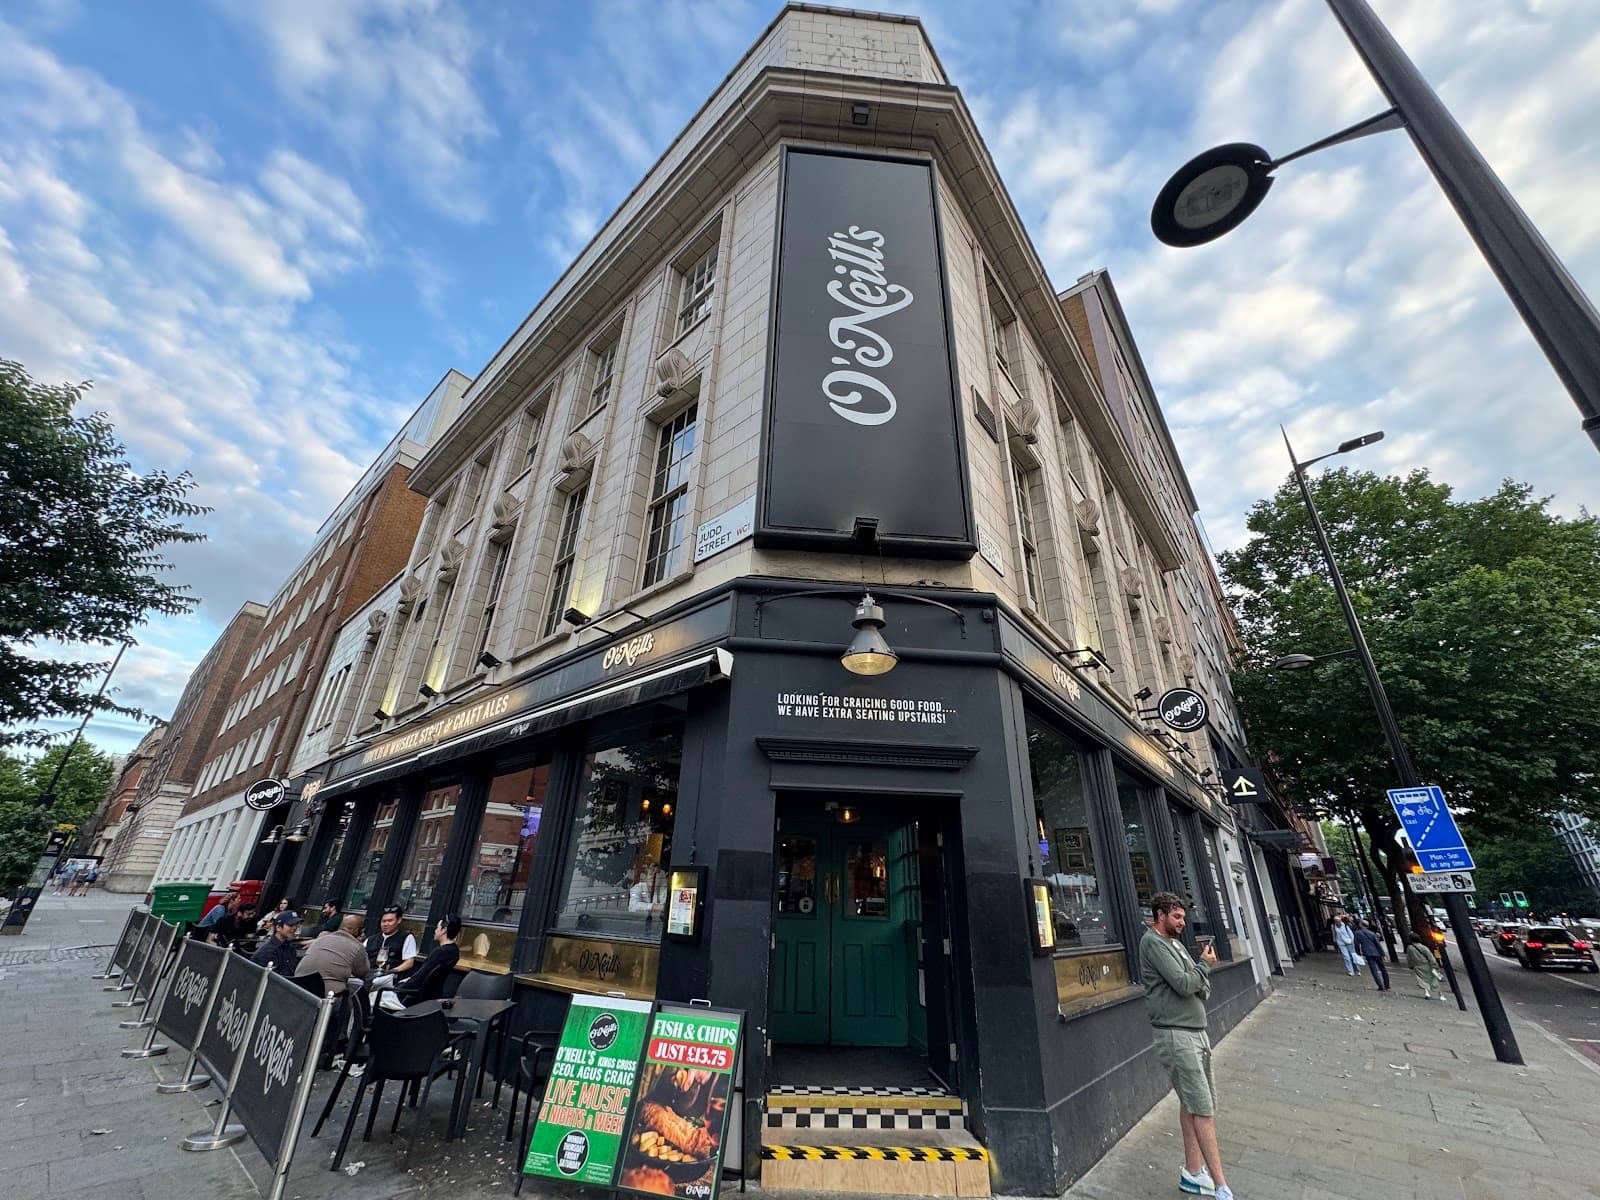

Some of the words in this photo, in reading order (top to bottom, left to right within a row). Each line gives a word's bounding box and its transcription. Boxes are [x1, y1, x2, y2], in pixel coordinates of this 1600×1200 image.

[822, 225, 913, 425] O'Neill's
[698, 531, 732, 556] STREET
[699, 525, 722, 544] JUDD
[603, 632, 655, 669] O'Neill's
[453, 705, 482, 730] CRAFT
[483, 694, 509, 721] ALES
[777, 693, 819, 706] LOOKING
[822, 694, 840, 706] FOR
[843, 696, 887, 709] CRAICING
[890, 699, 915, 711] GOOD
[778, 705, 792, 716] WE
[795, 706, 819, 717] HAVE
[823, 707, 852, 719] EXTRA
[855, 709, 895, 722] SEATING
[898, 711, 947, 724] UPSTAIRS!
[1165, 696, 1198, 721] O'Neill's
[580, 949, 621, 980] O'Neill's
[174, 966, 209, 1015] O'Neill's
[652, 1019, 684, 1038] FISH
[684, 1025, 696, 1040] &
[697, 1027, 737, 1046] CHIPS
[254, 1014, 294, 1095] O'Neill's
[556, 1046, 596, 1066] O'NEILL'S
[655, 1042, 687, 1061] JUST
[687, 1046, 727, 1067] £13.75
[553, 1061, 575, 1077] CEOL
[577, 1065, 601, 1081] AGUS
[604, 1069, 634, 1086] CRAIC
[543, 1077, 579, 1106] LIVE
[579, 1082, 631, 1113] MUSIC
[538, 1104, 546, 1122] 4
[550, 1106, 587, 1128] NIGHTS
[594, 1112, 625, 1135] WEEK
